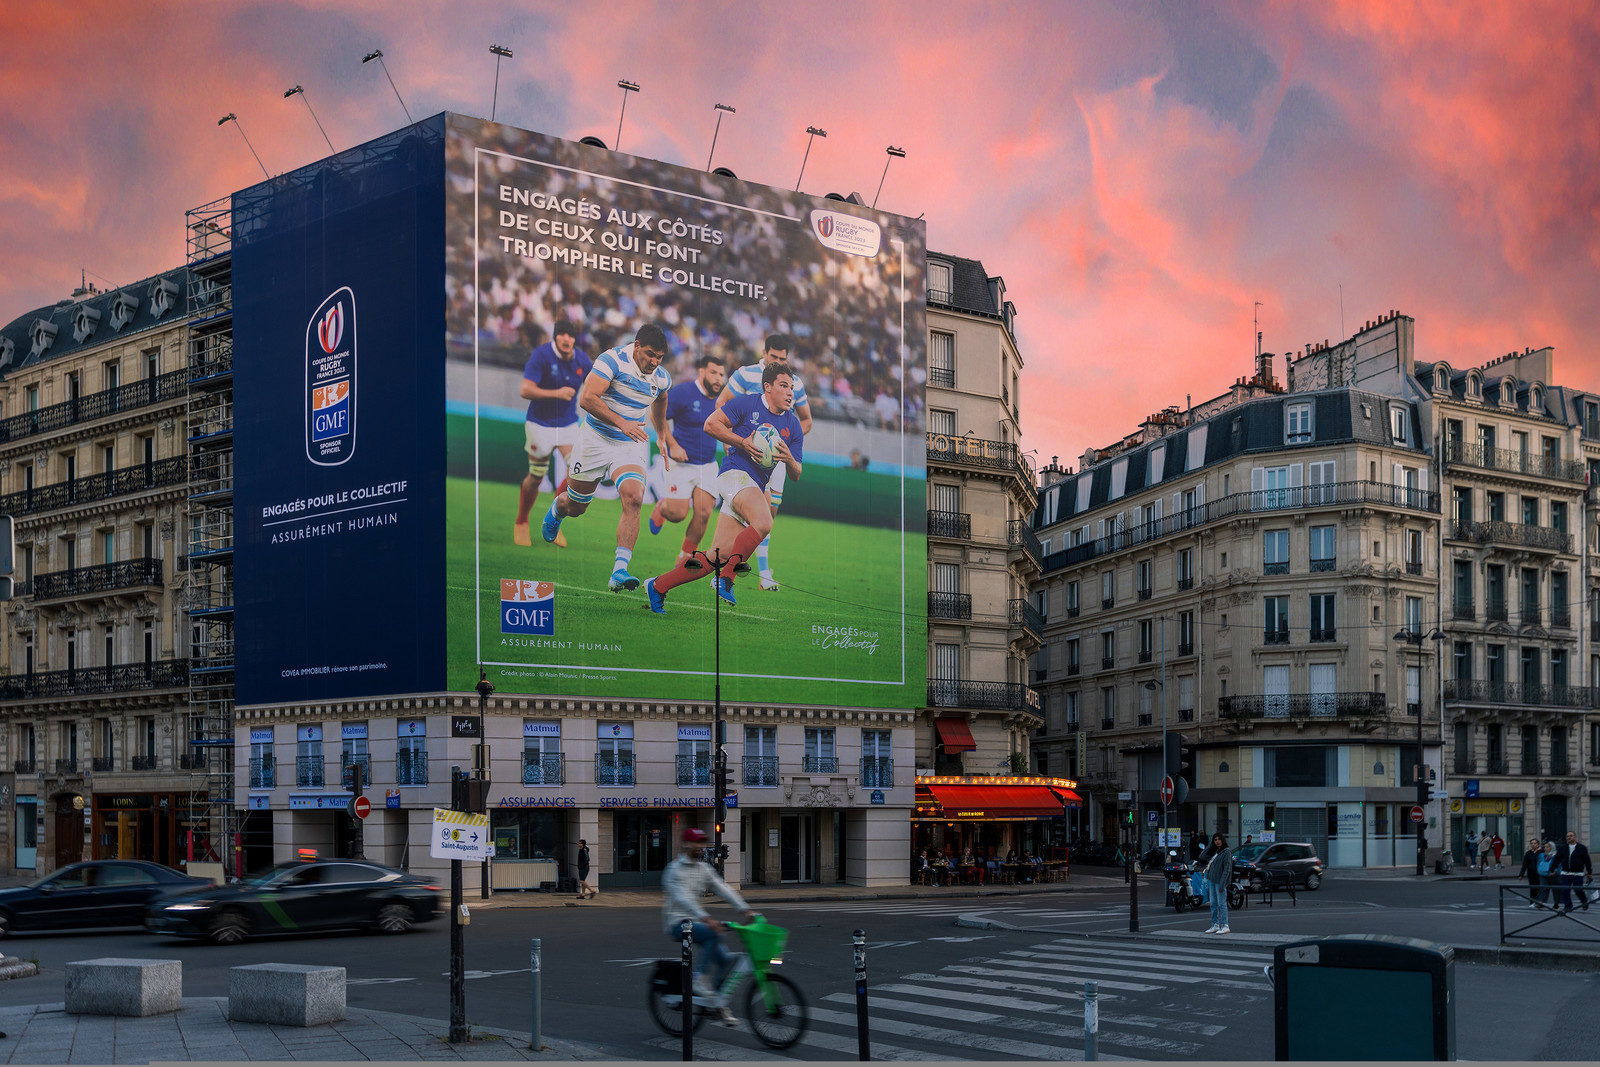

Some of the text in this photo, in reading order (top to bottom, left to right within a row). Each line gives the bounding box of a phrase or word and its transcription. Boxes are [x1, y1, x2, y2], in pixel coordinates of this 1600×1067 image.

[500, 184, 723, 246] ENGAGÉS AUX CÔTÉS
[836, 220, 850, 229] COUPE
[836, 226, 858, 236] RUGBY
[836, 232, 853, 241] FRANCE
[499, 210, 701, 264] DE CEUX QUI FONT
[499, 236, 768, 301] TRIOMPHER LE COLLECTIF.
[312, 356, 326, 366] COUPE
[333, 350, 350, 361] MONDE
[320, 358, 342, 372] RUGBY
[316, 367, 345, 379] FRANCE 2023
[316, 410, 346, 432] GMF
[320, 440, 342, 450] SPONSOR
[321, 447, 340, 456] OFFICIEL
[573, 462, 582, 474] 6
[262, 480, 407, 518] ENGAGÉS POUR LE COLLECTIF
[271, 512, 398, 544] ASSURÉMENT HUMAIN
[505, 608, 551, 627] GMF
[812, 625, 858, 636] ENGAGÉS
[501, 638, 622, 652] ASSURÉMENT HUMAIN
[822, 633, 880, 655] Collectif
[282, 669, 300, 677] COVEA
[300, 666, 330, 676] IMMOBILIER
[1025, 687, 1041, 710] HOTEL
[342, 727, 367, 735] Matmut
[524, 724, 559, 733] Matmut
[678, 728, 711, 736] Matmut
[250, 731, 273, 740] Matmut
[329, 799, 350, 807] Matm
[500, 797, 576, 807] ASSURANCES
[600, 797, 716, 807] SERVICES FINANCIERS
[441, 842, 478, 851] Saint-Augustin
